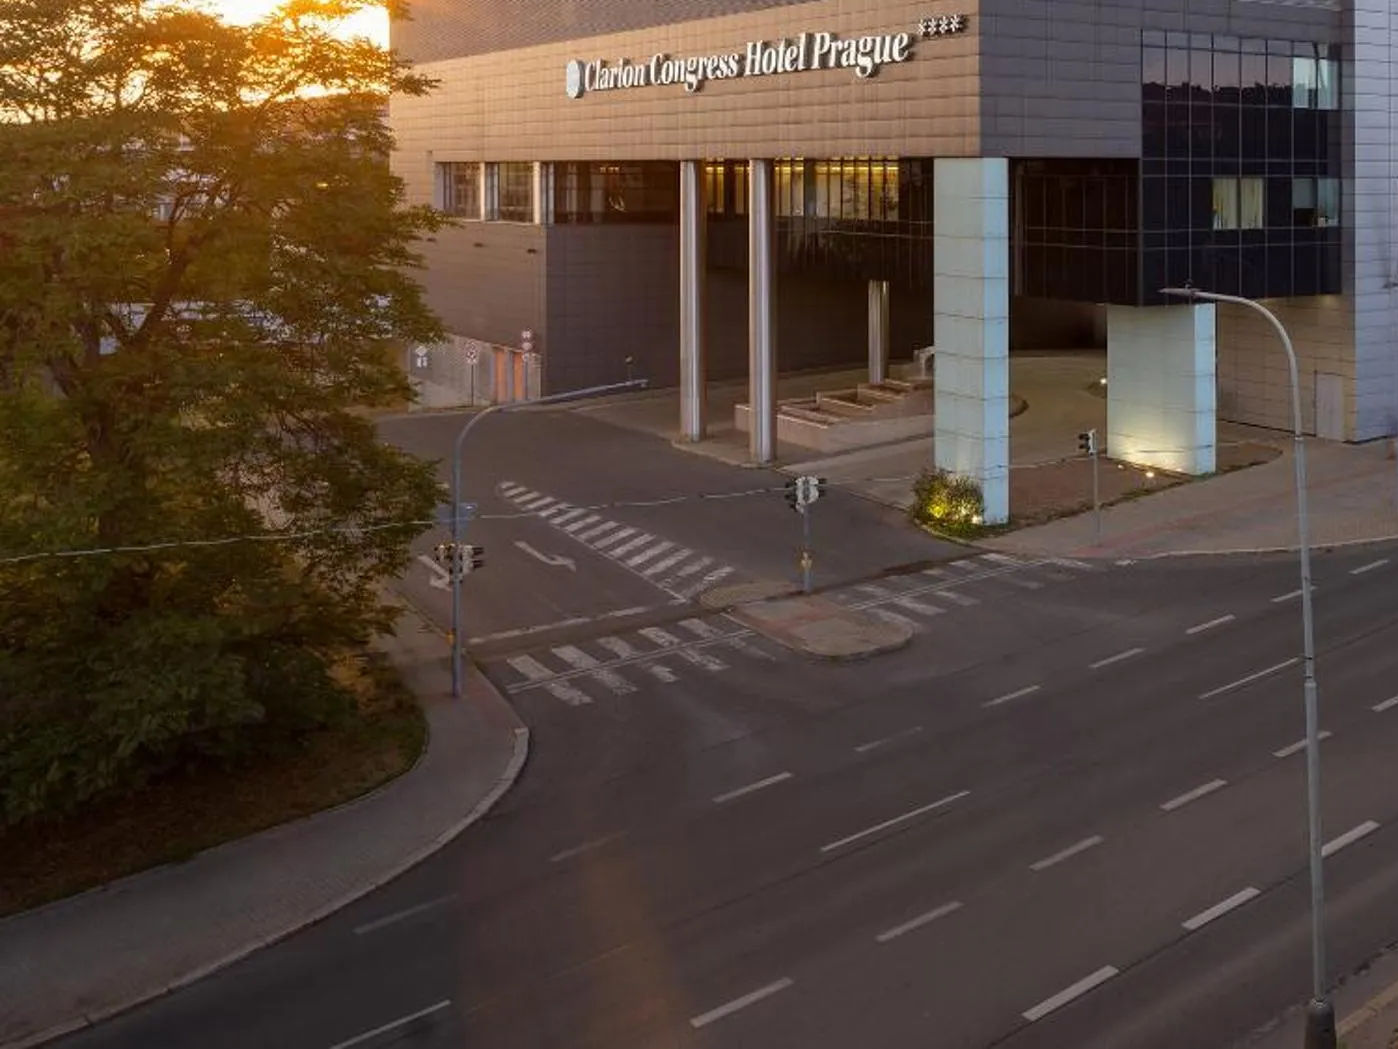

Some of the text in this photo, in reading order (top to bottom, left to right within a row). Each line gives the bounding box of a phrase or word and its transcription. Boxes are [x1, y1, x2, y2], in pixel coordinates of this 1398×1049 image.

[585, 31, 910, 93] Clarion Congress Hotel Prague
